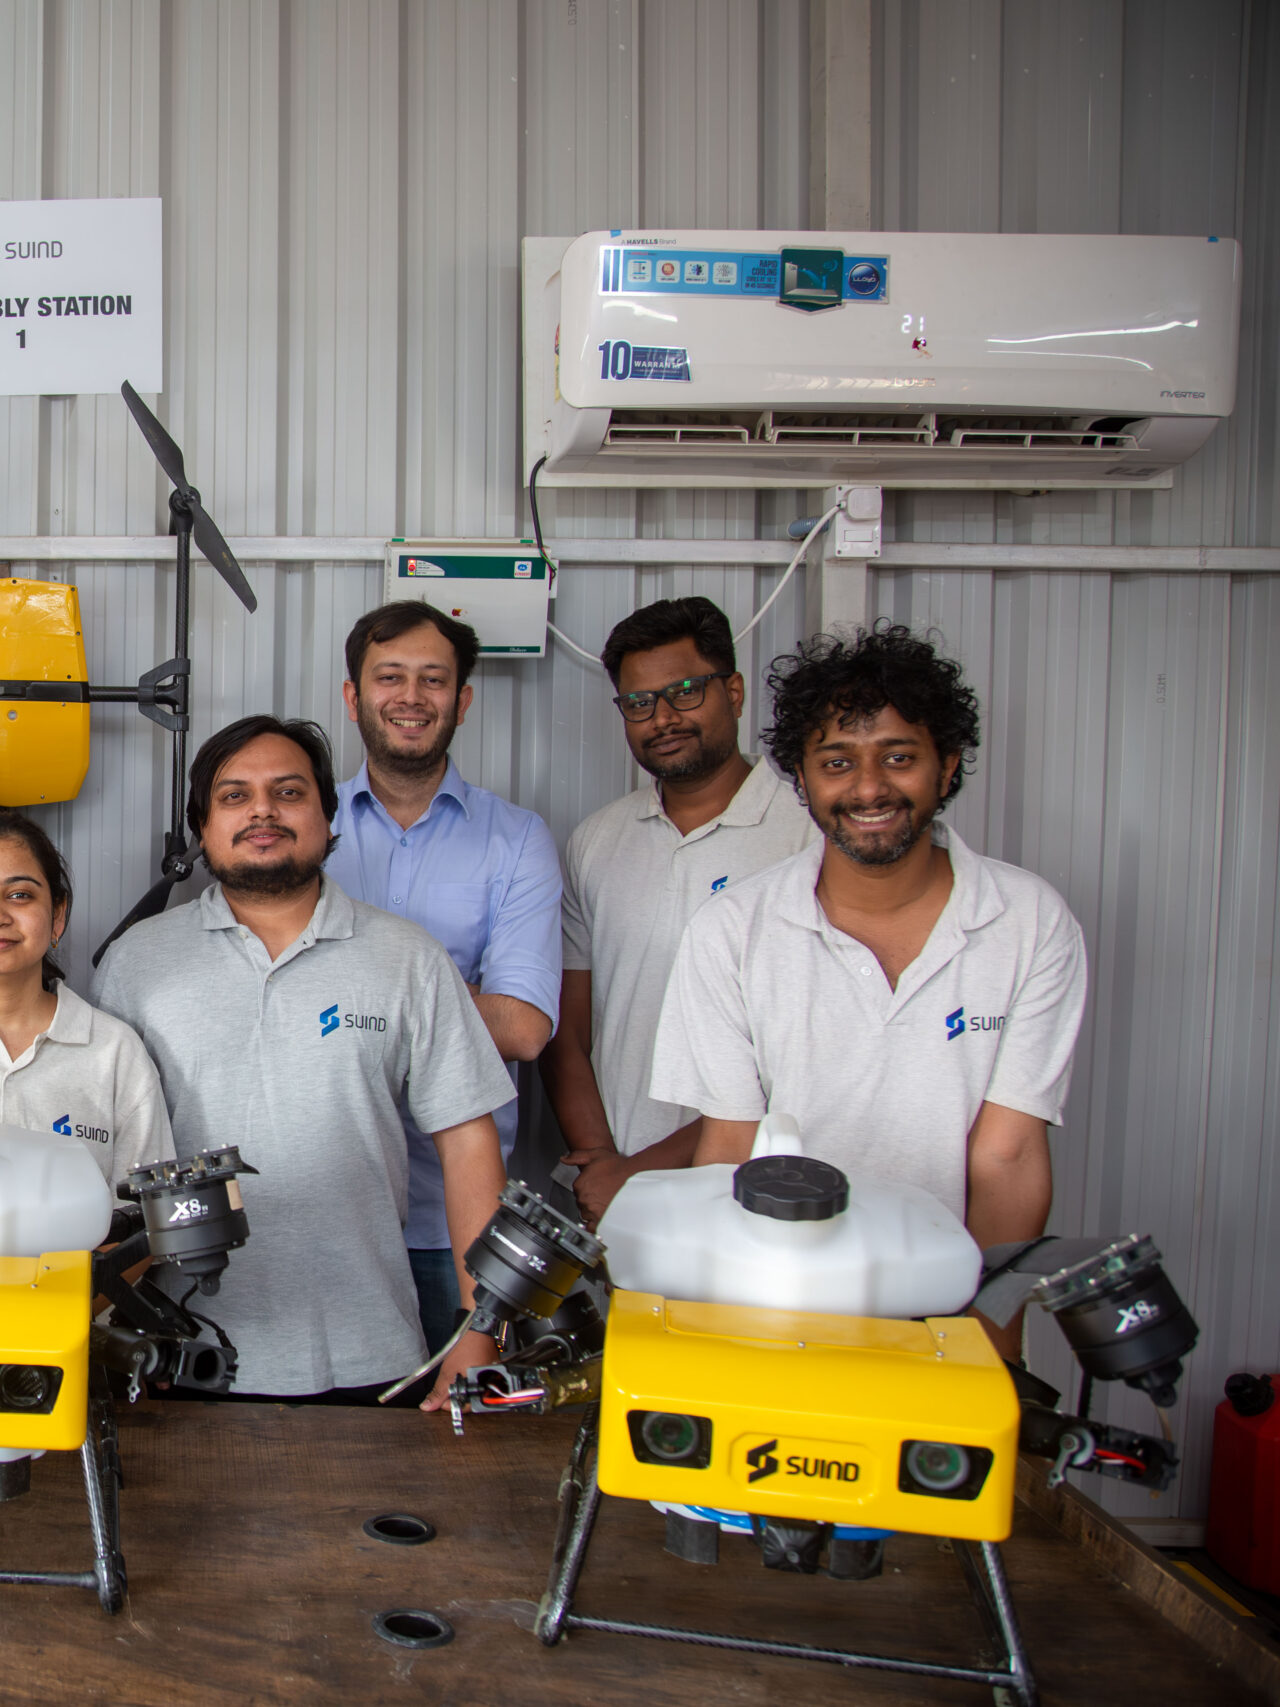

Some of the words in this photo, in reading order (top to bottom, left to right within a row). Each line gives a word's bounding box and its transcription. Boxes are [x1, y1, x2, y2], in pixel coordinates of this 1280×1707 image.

[5, 240, 63, 260] SUIND
[37, 295, 132, 317] STATION
[901, 313, 924, 334] 21
[15, 329, 26, 349] 1
[599, 340, 631, 380] 10
[1160, 390, 1206, 399] INVERTER
[344, 1013, 387, 1032] SUIND
[969, 1015, 1006, 1032] SUIN
[75, 1124, 109, 1144] SUIND
[785, 1455, 860, 1482] SUIND
